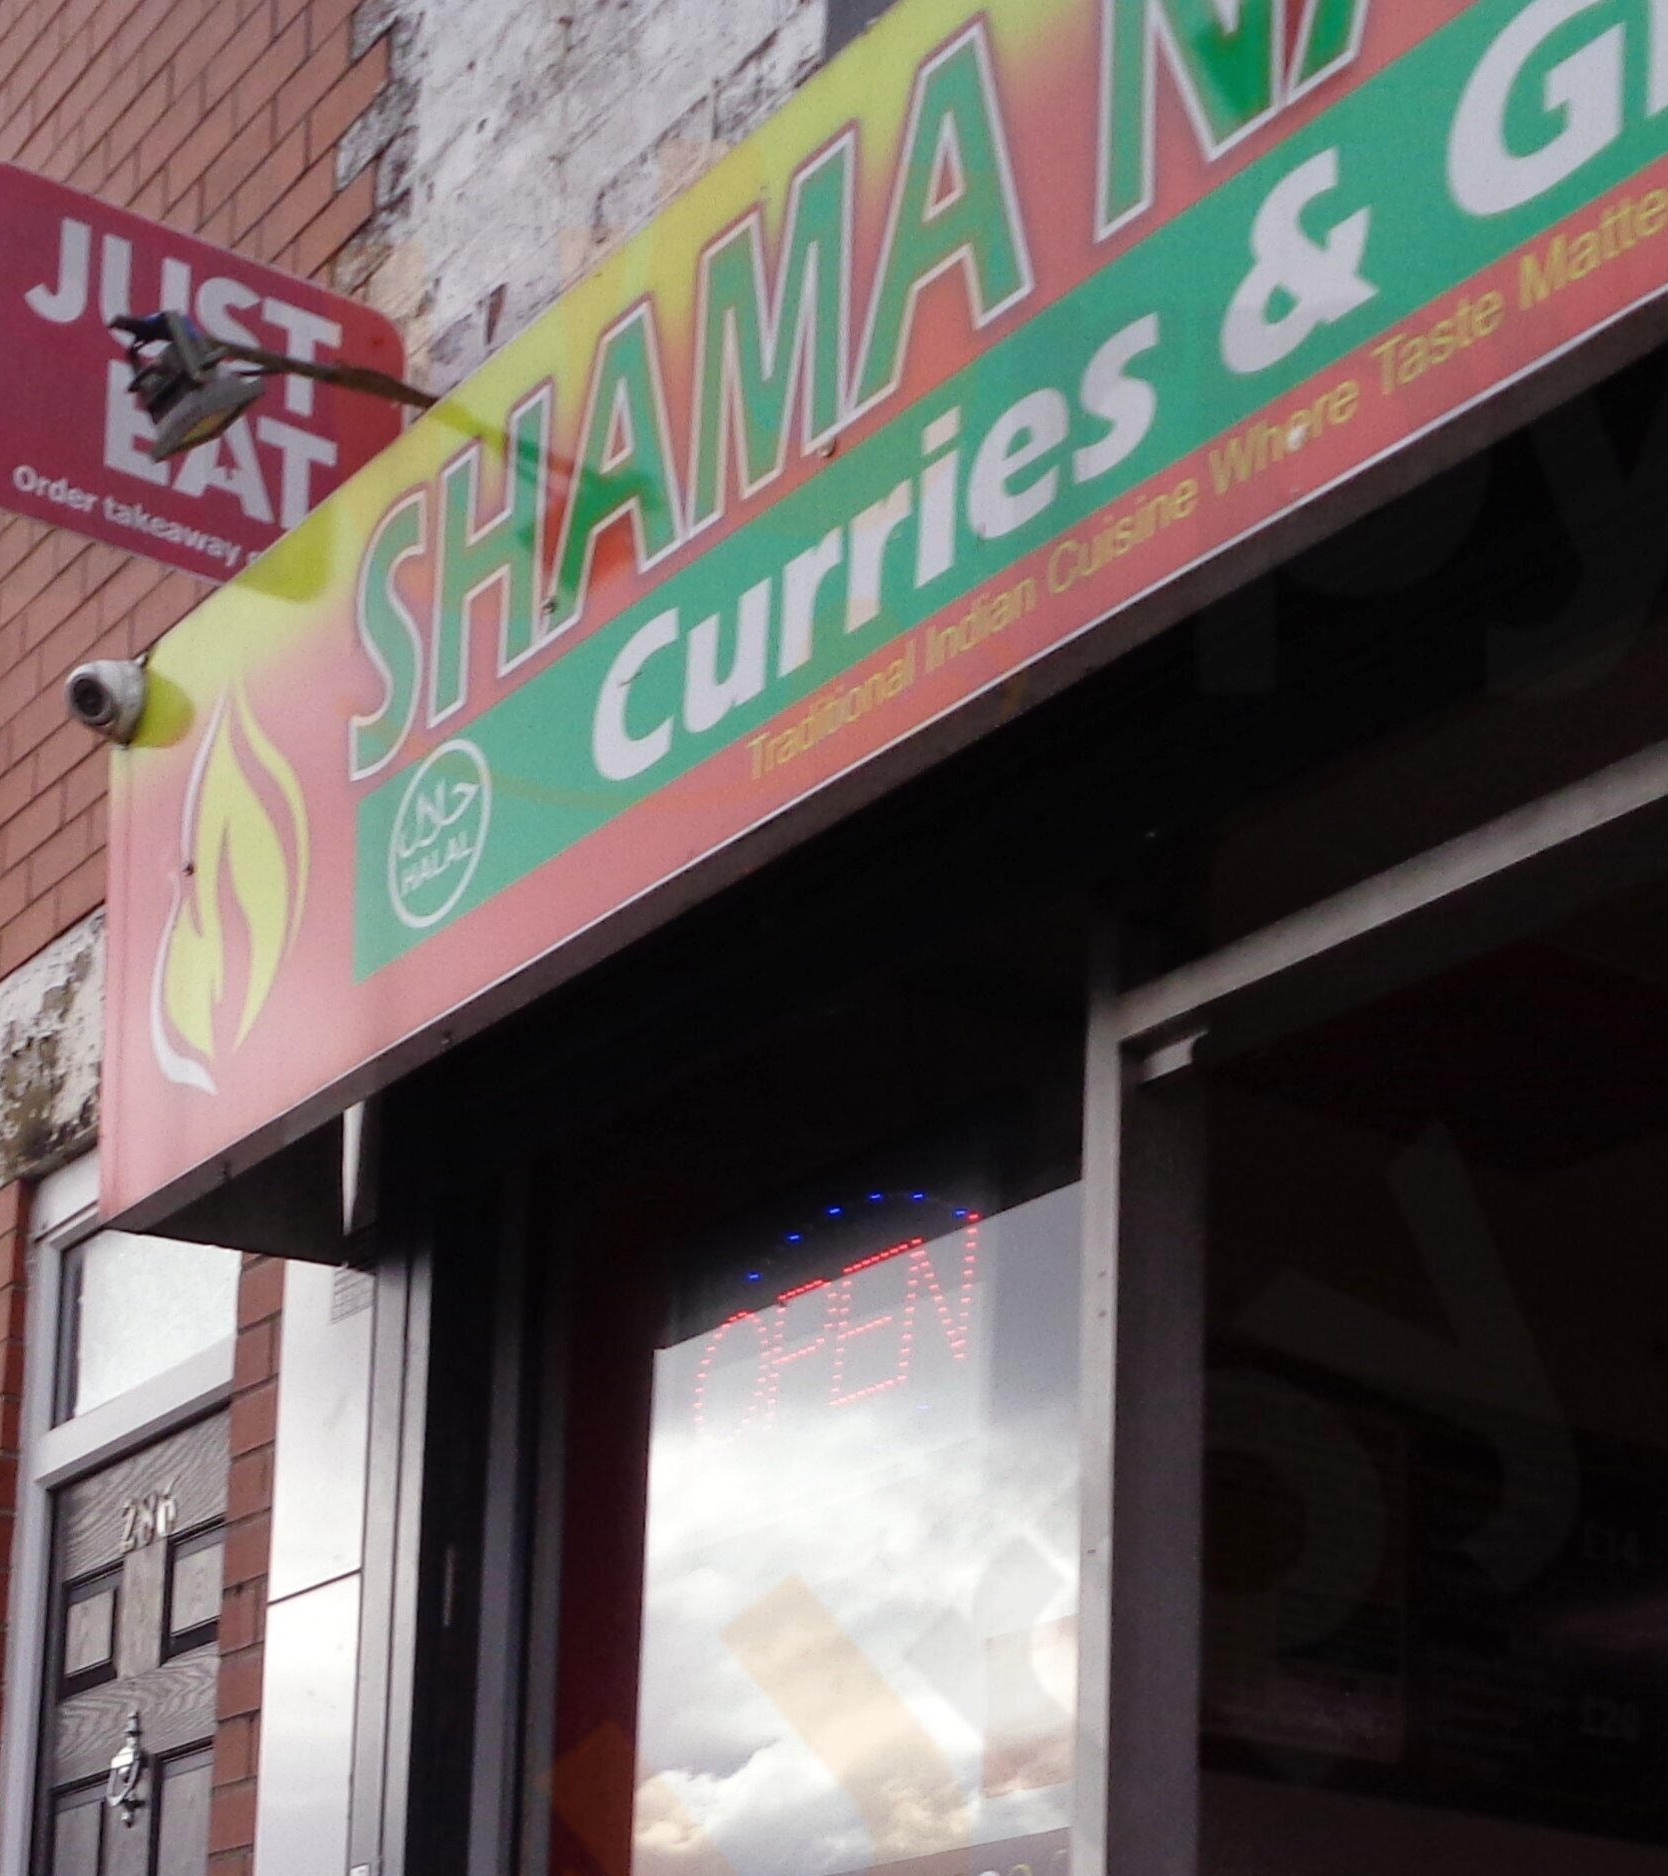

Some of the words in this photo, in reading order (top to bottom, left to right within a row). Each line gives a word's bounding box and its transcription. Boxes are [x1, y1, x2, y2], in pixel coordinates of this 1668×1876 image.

[24, 216, 343, 417] JUST
[349, 15, 1035, 785] SHAMA
[12, 464, 97, 512] Order
[103, 499, 241, 566] takeaway
[104, 360, 338, 530] EAT
[592, 310, 1160, 783] Curries
[1220, 145, 1380, 374] &
[747, 639, 916, 779] Traditional
[925, 574, 1034, 672] Indian
[1047, 477, 1198, 594] Cuisine
[1371, 290, 1504, 395] Taste
[400, 831, 474, 898] HALAL
[694, 1212, 983, 1445] OPEN
